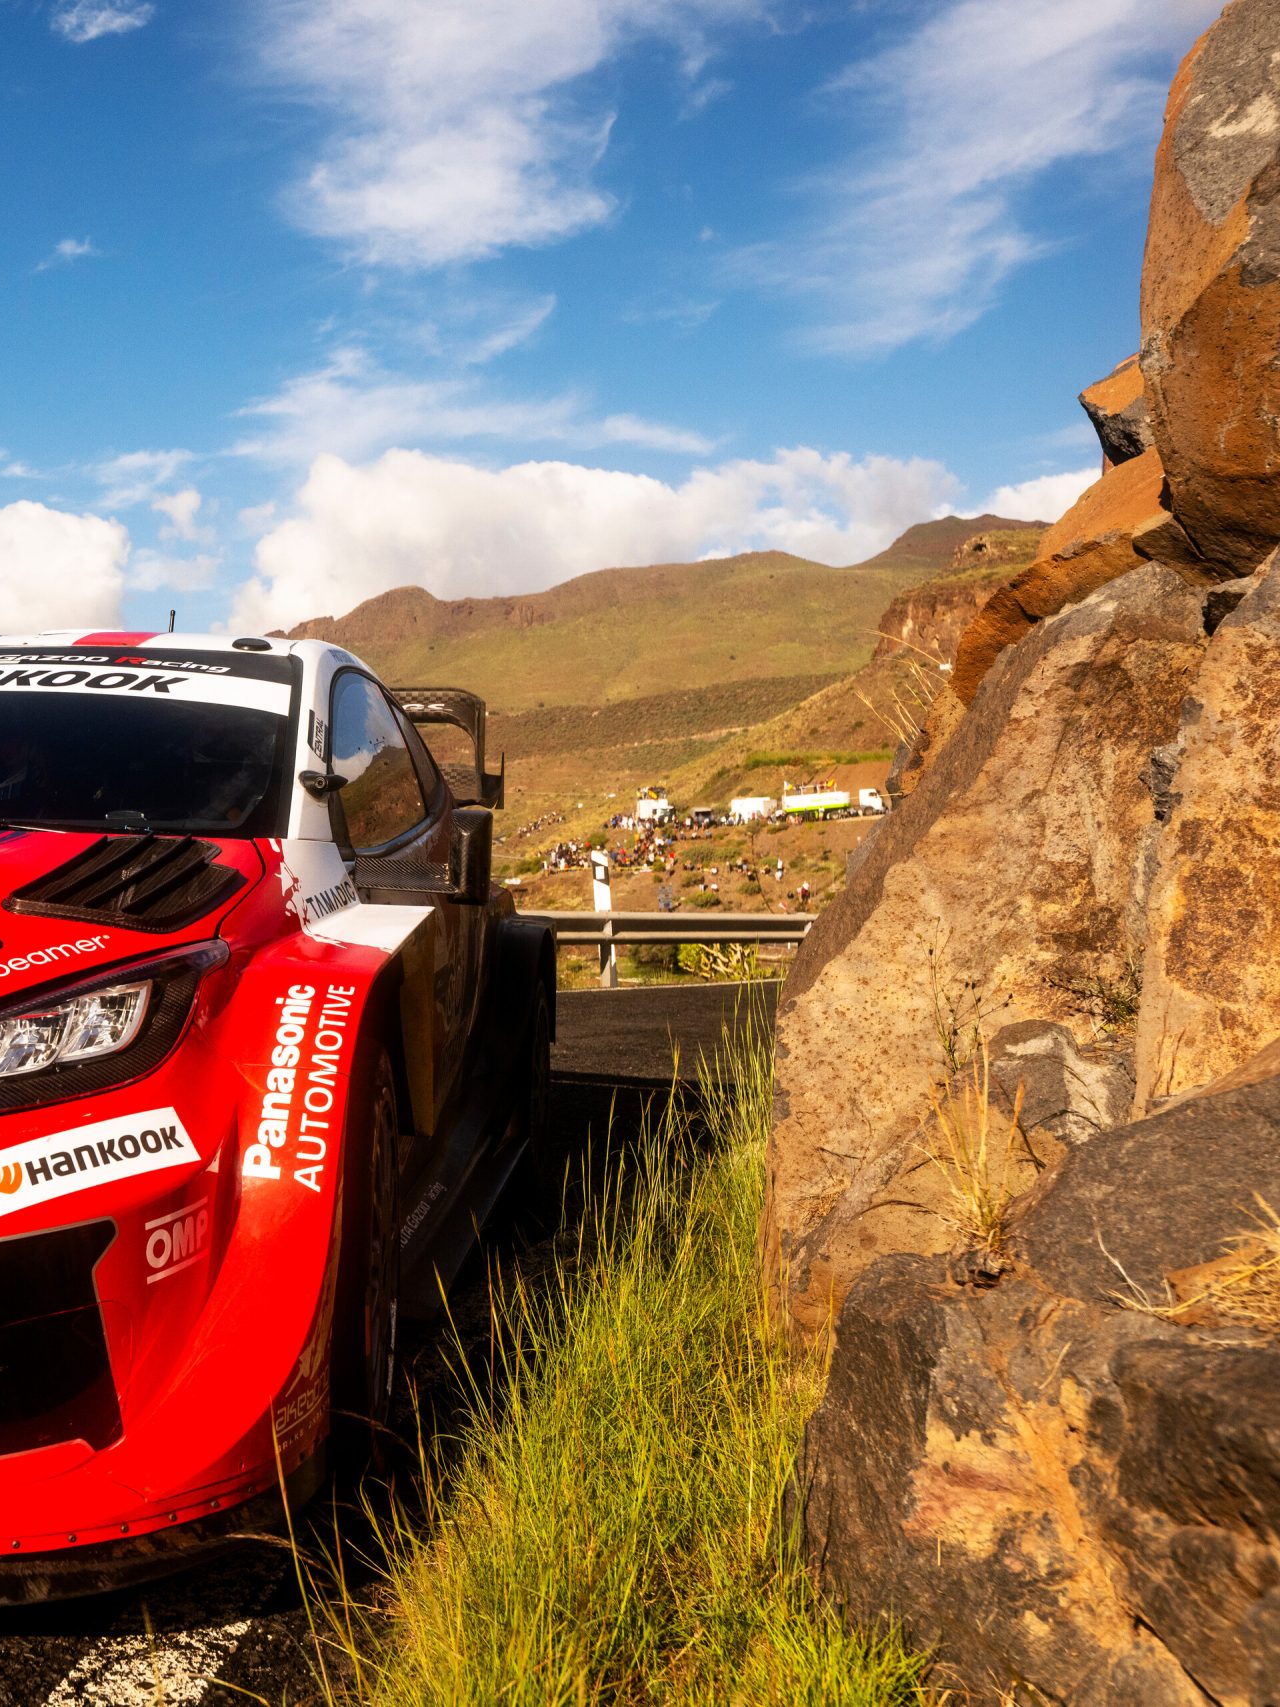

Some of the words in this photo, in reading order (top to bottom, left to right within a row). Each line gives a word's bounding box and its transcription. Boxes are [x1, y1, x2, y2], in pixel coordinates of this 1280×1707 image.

[114, 656, 231, 674] Racing
[305, 880, 357, 919] TAMADIC
[242, 984, 316, 1180] Panasonic
[293, 984, 356, 1193] AUTOMOTIVE
[145, 1209, 209, 1269] OMP
